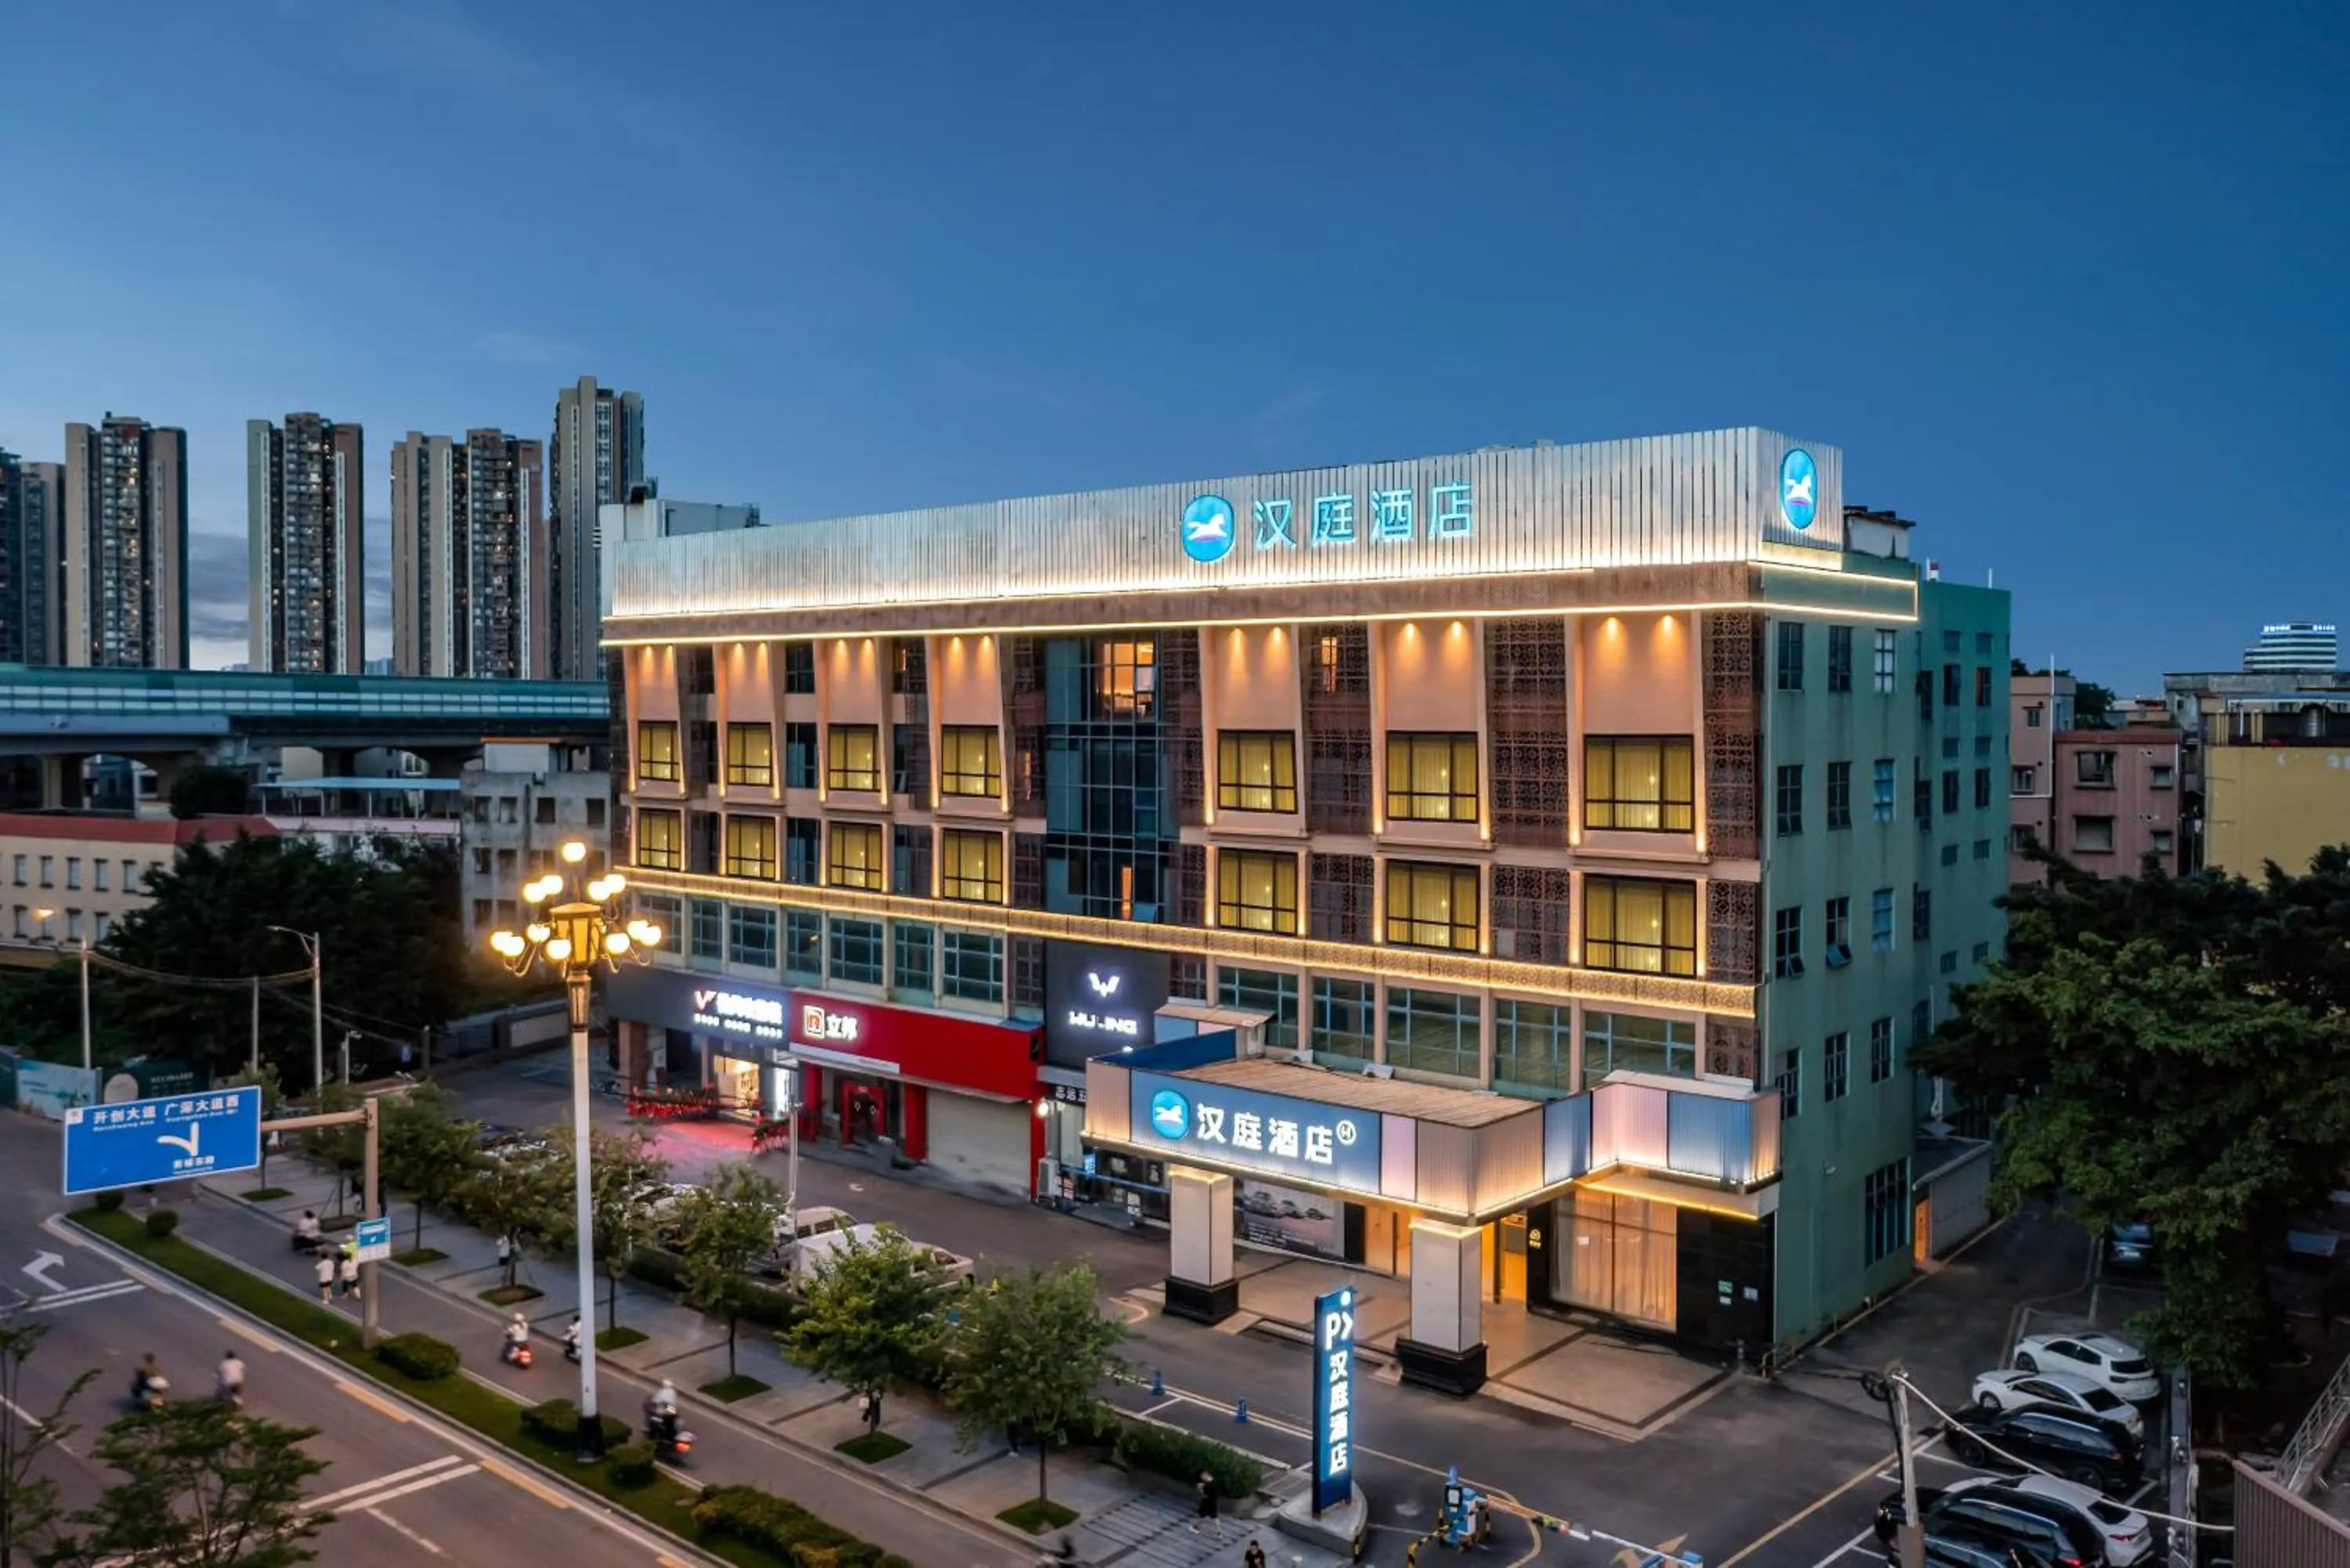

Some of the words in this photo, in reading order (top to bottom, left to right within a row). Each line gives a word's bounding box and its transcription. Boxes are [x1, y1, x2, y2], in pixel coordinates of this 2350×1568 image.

[1253, 482, 1473, 550] 汉庭酒店
[1197, 1103, 1333, 1165] 汉庭酒店
[1329, 1350, 1350, 1476] 汉庭酒店
